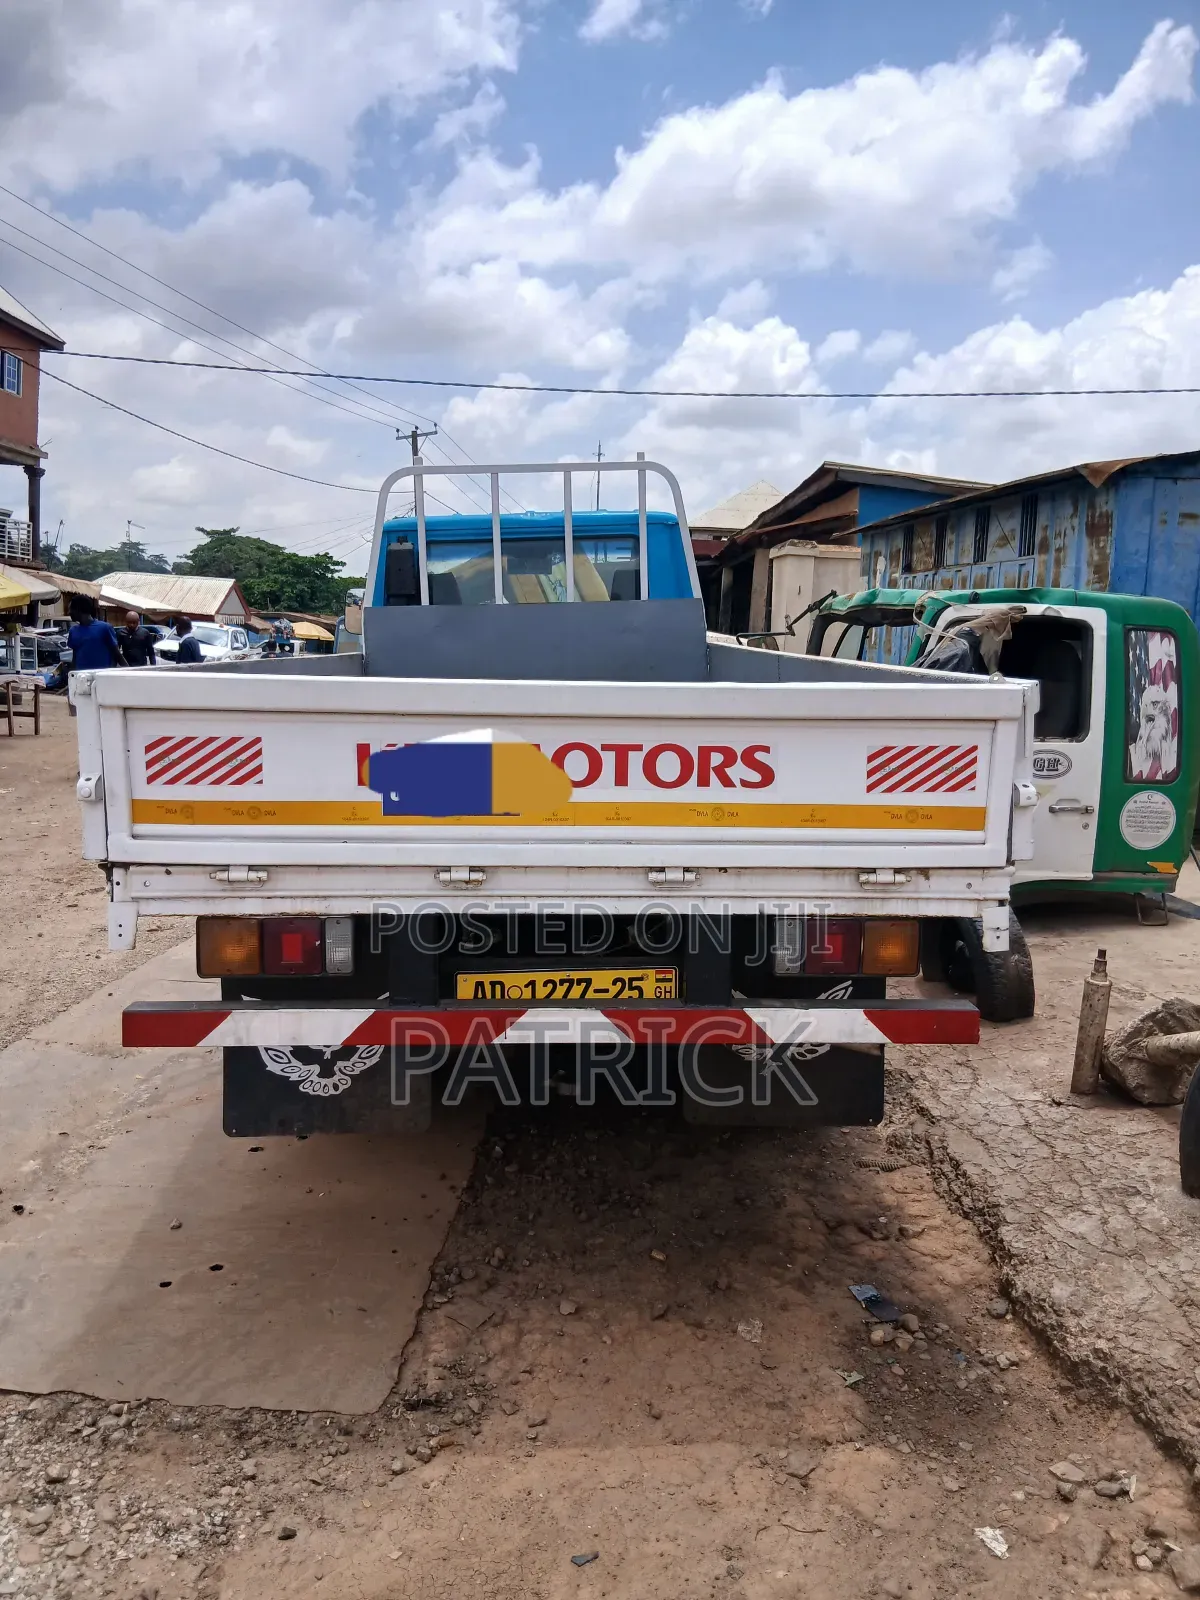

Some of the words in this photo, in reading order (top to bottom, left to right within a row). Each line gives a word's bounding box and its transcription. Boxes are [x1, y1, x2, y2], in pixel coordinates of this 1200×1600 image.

[531, 742, 775, 790] OTORS
[524, 977, 644, 999] 1277-25
[654, 986, 672, 999] GH
